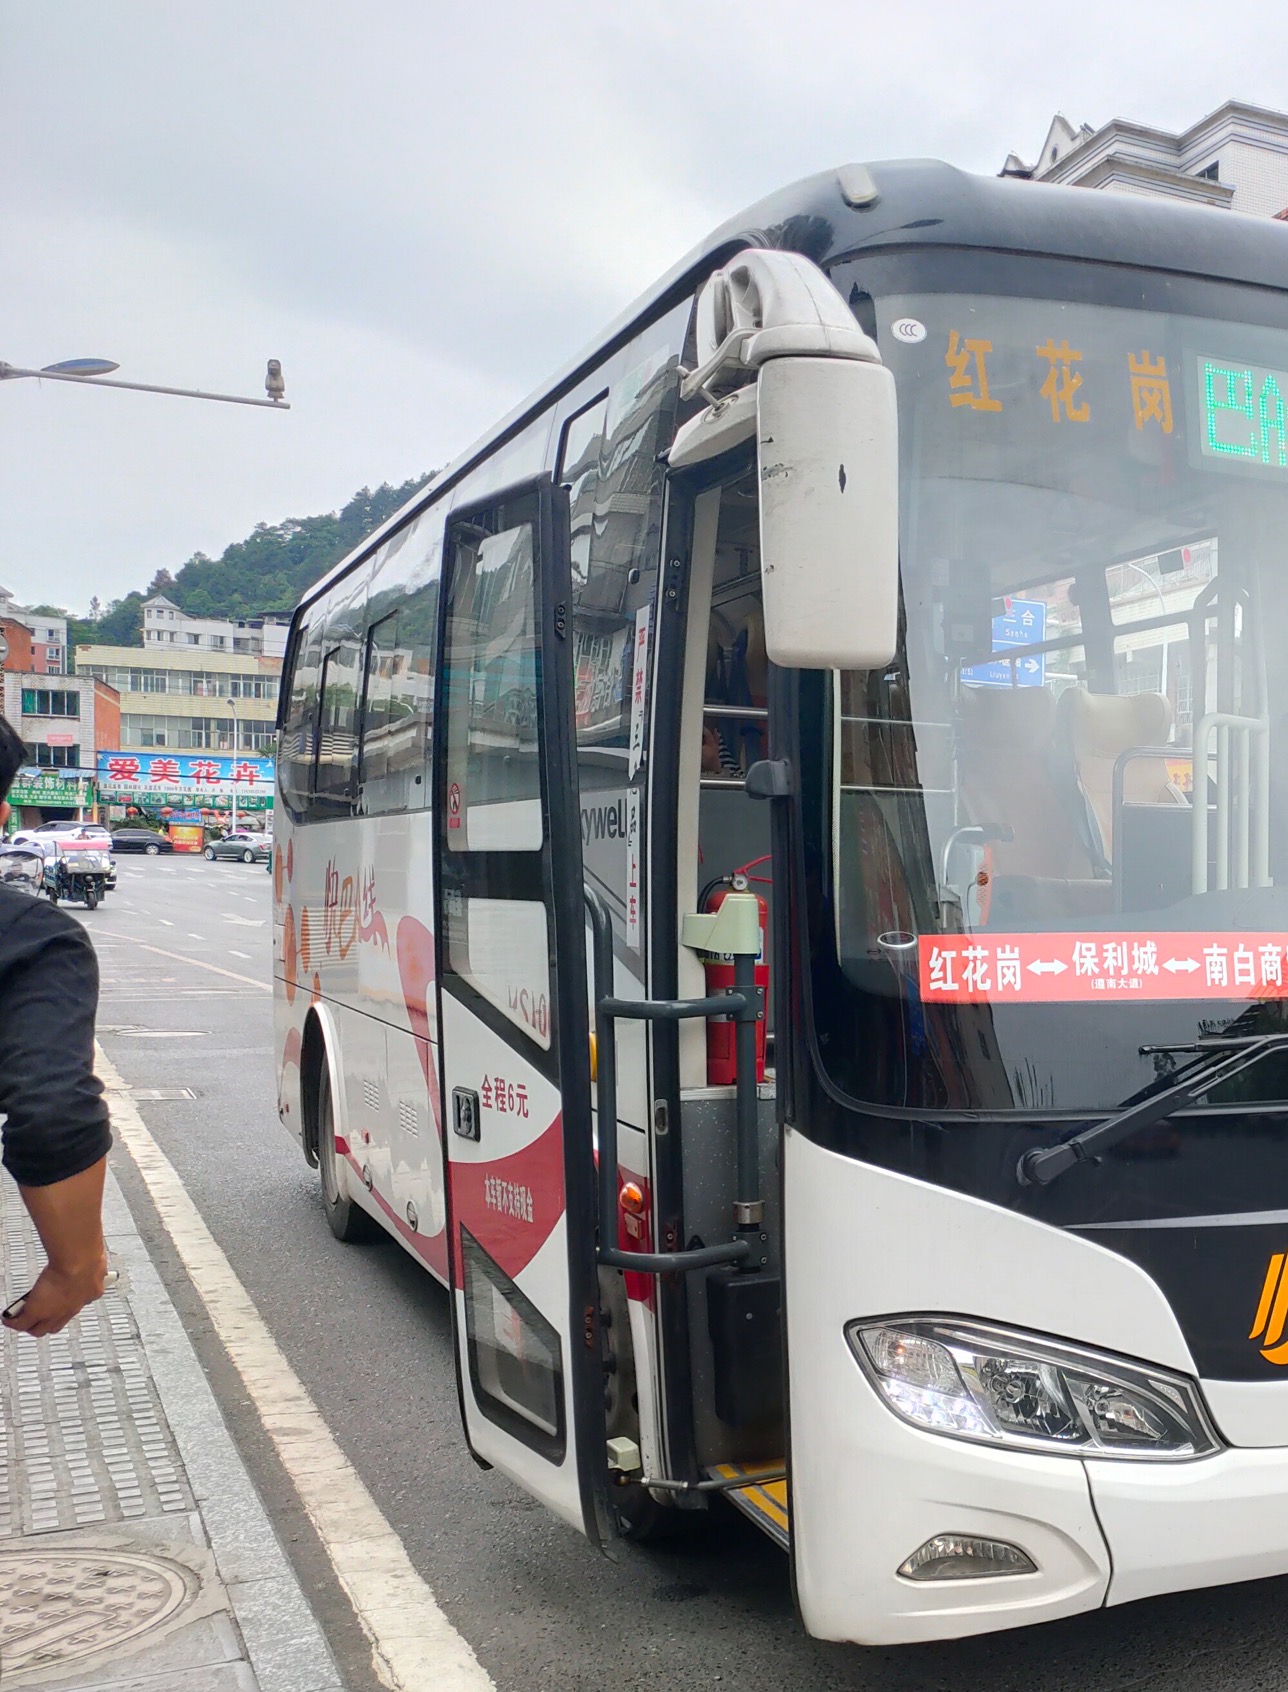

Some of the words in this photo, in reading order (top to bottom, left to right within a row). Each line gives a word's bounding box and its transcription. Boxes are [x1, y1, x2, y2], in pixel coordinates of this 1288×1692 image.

[945, 329, 1174, 434] 红花岗
[109, 756, 260, 786] 爱美花卉
[582, 798, 627, 846] ywel
[928, 944, 1022, 992] 红花岗
[1071, 940, 1160, 977] 保利城
[481, 1074, 529, 1118] 全程6元
[484, 1173, 534, 1223] 本车暂不支持现金
